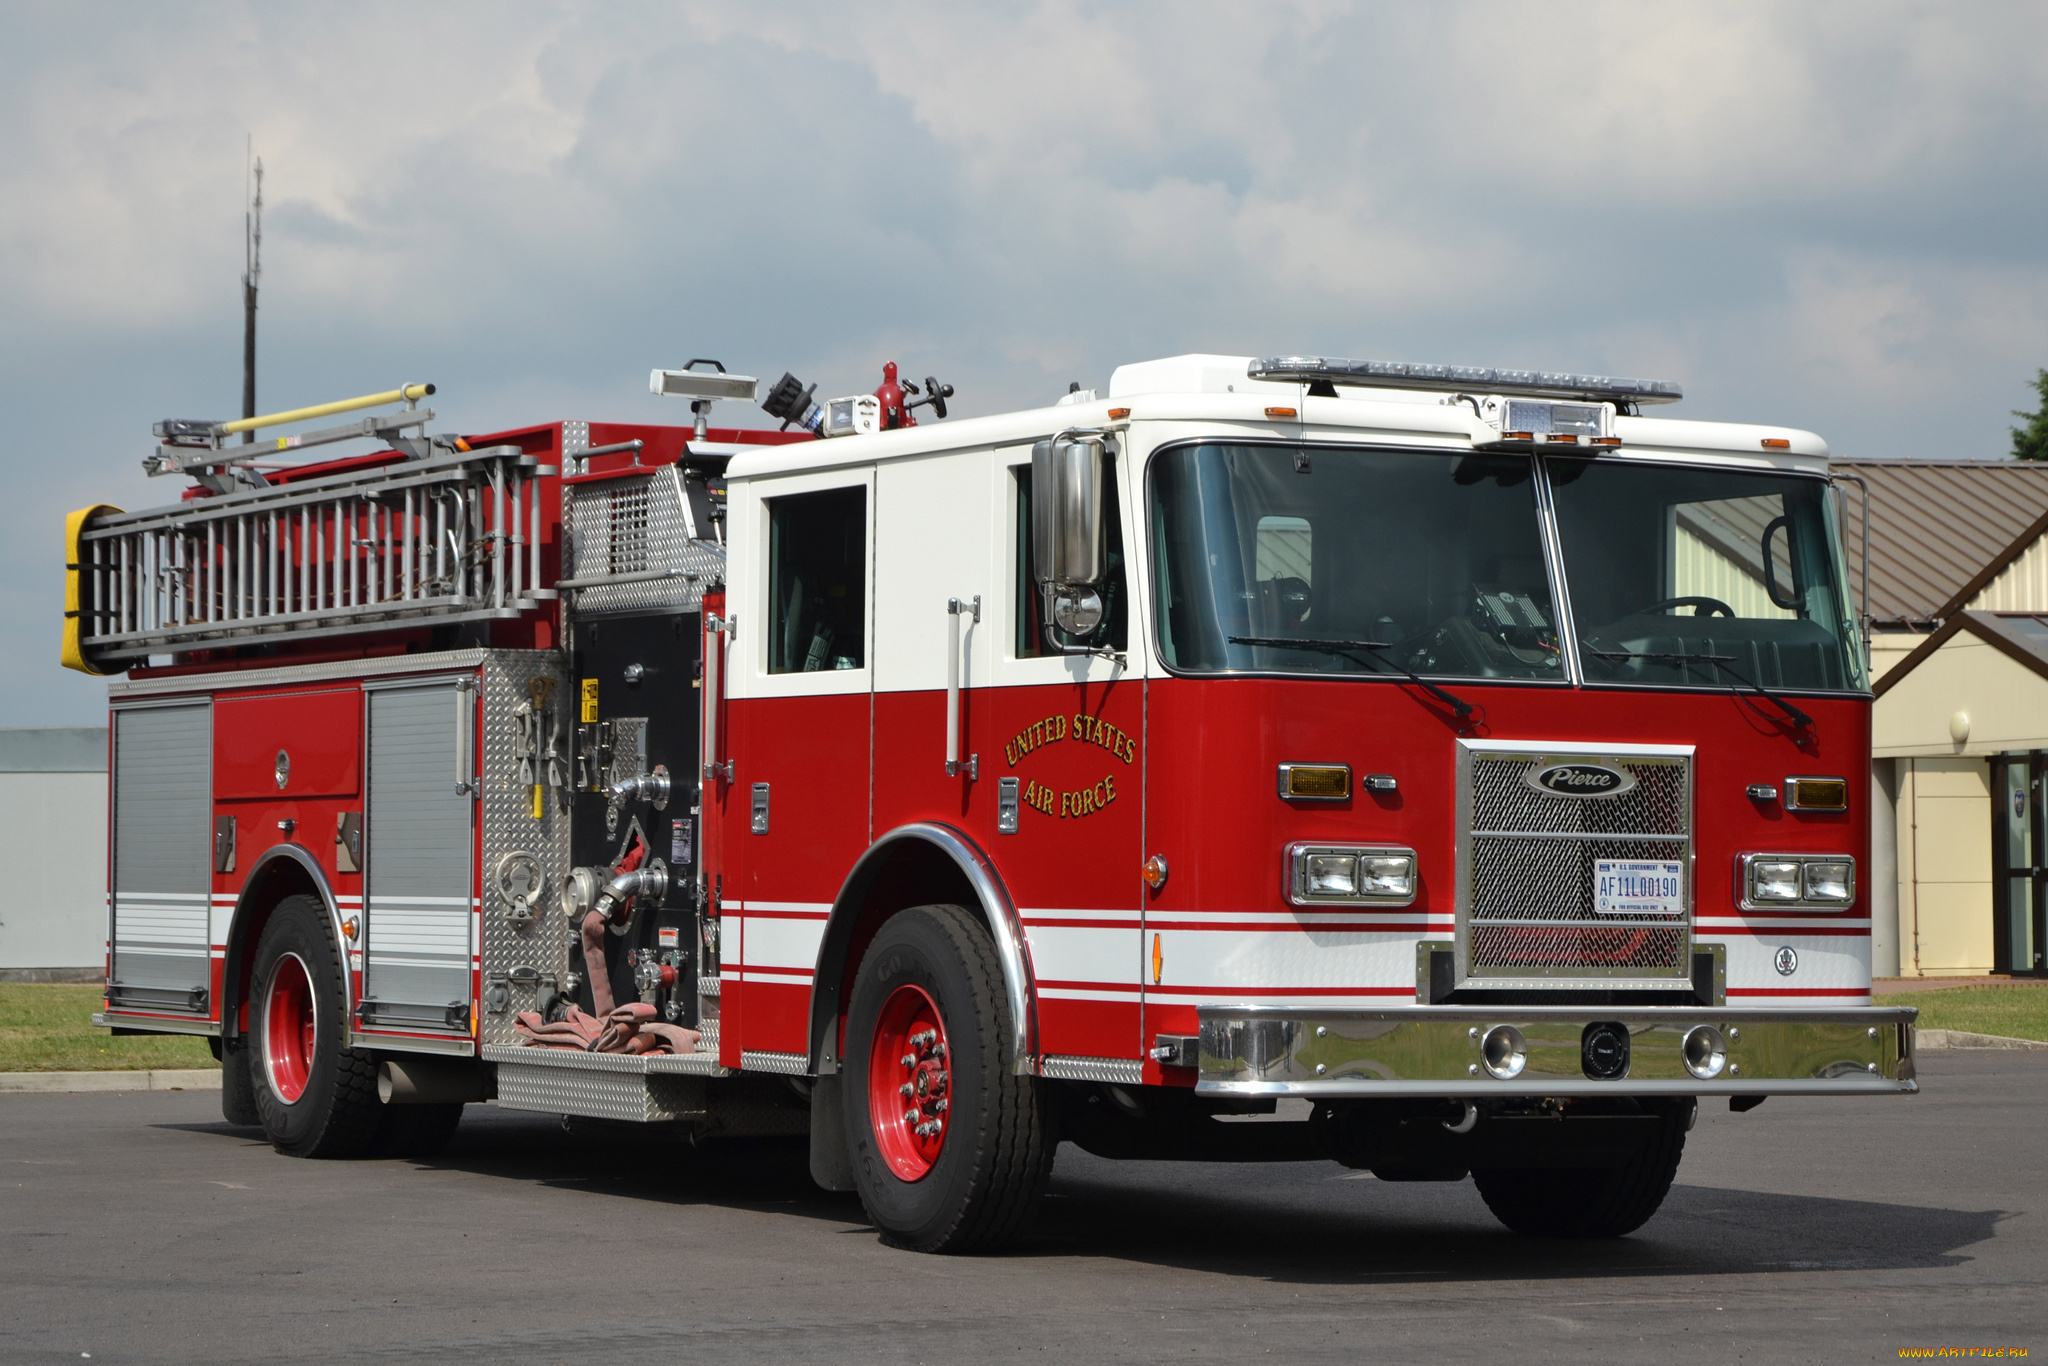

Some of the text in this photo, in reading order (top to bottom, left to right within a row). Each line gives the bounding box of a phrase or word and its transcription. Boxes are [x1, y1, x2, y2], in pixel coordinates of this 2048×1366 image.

[1005, 713, 1137, 768] UNITED STATES
[1548, 767, 1612, 788] Pierce
[1022, 773, 1117, 819] AIR FORCE
[1599, 876, 1677, 897] AF11L00190
